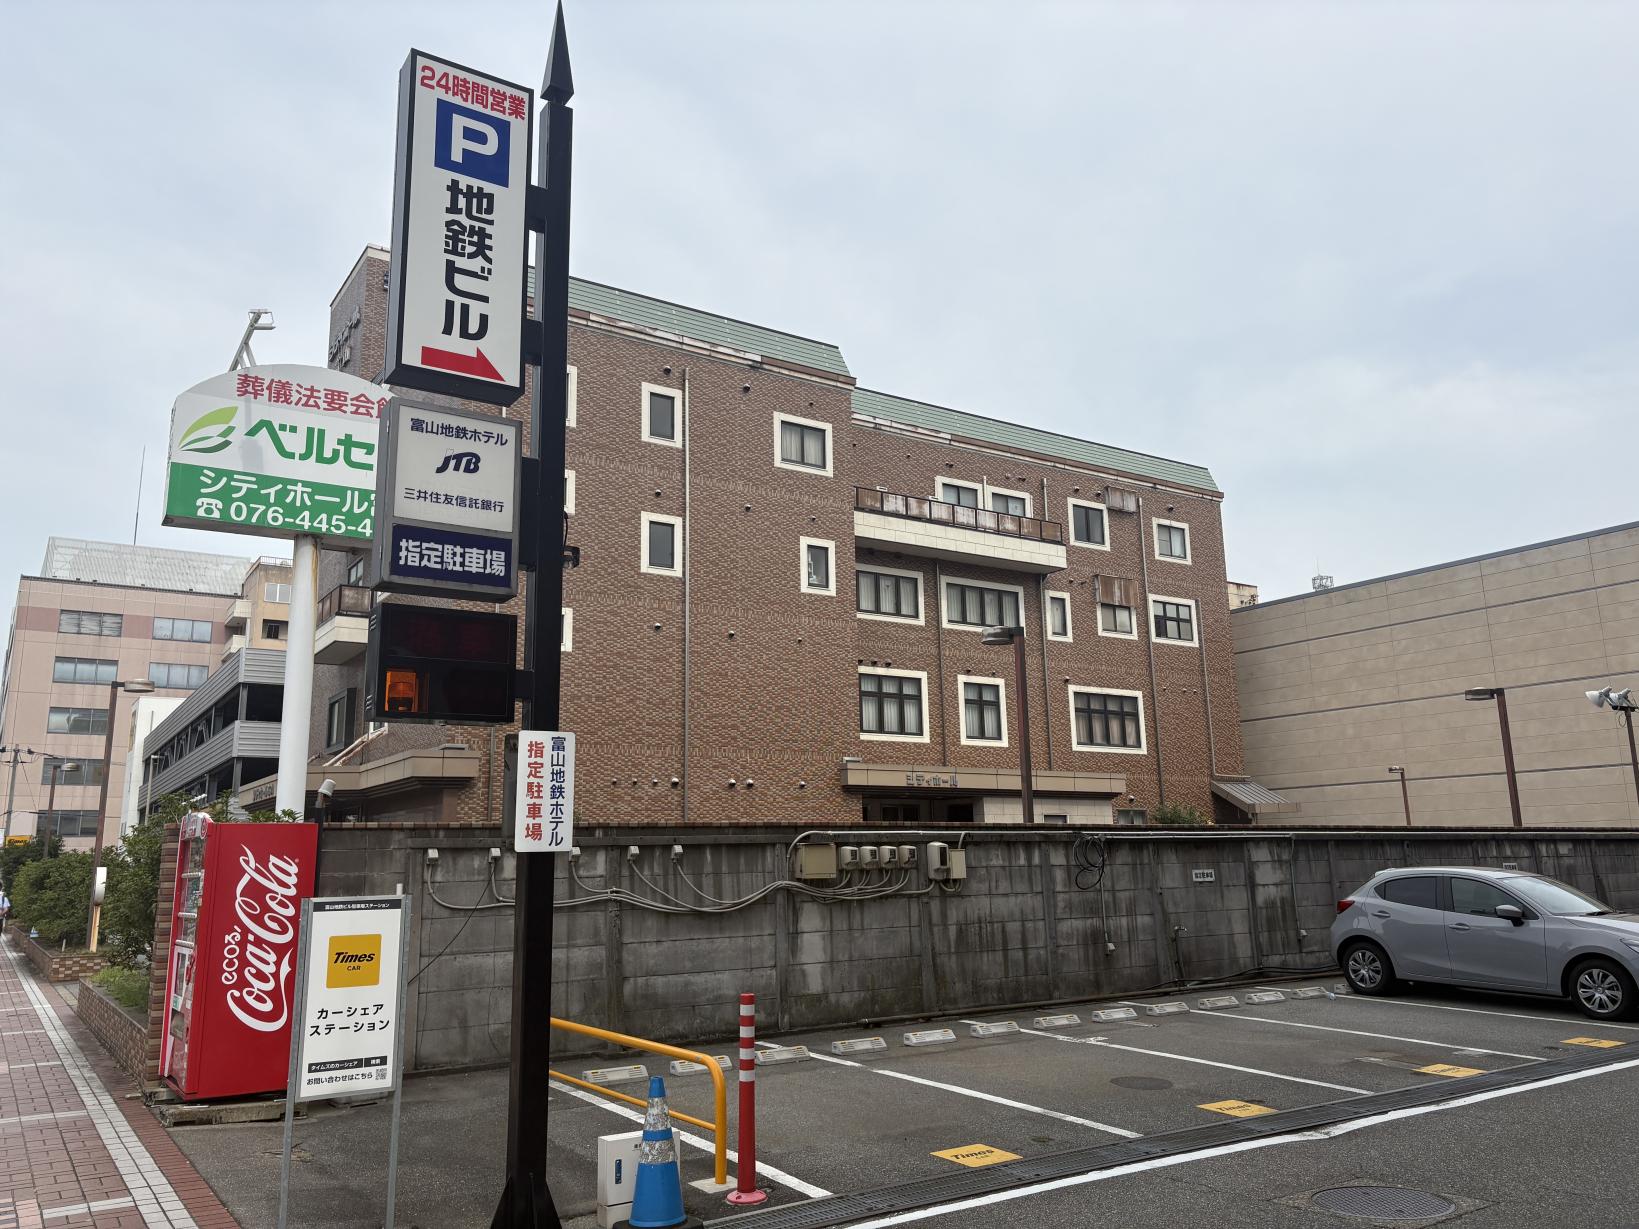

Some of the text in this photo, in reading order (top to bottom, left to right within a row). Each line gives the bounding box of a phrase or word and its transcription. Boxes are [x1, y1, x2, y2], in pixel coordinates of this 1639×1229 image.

[419, 65, 526, 121] 24時間営業
[450, 113, 499, 164] P
[441, 178, 495, 341] 地鉄ビル
[410, 417, 508, 447] 富山地鉄ホテル
[435, 451, 481, 474] JTB
[199, 469, 376, 517] シティホール
[403, 487, 505, 513] 三井住友信託銀行
[229, 501, 373, 537] 076-445-4
[398, 538, 506, 577] 指定駐車場
[524, 740, 546, 842] 指定駐車場
[548, 736, 567, 847] 富山地鉄ホテル
[226, 843, 300, 1032] Coca-Cola
[333, 951, 376, 964] Times
[309, 1019, 390, 1037] ステーション
[316, 1003, 385, 1020] カーシェア
[306, 1071, 373, 1086] お問い合わせはこちら
[950, 1149, 995, 1160] Times
